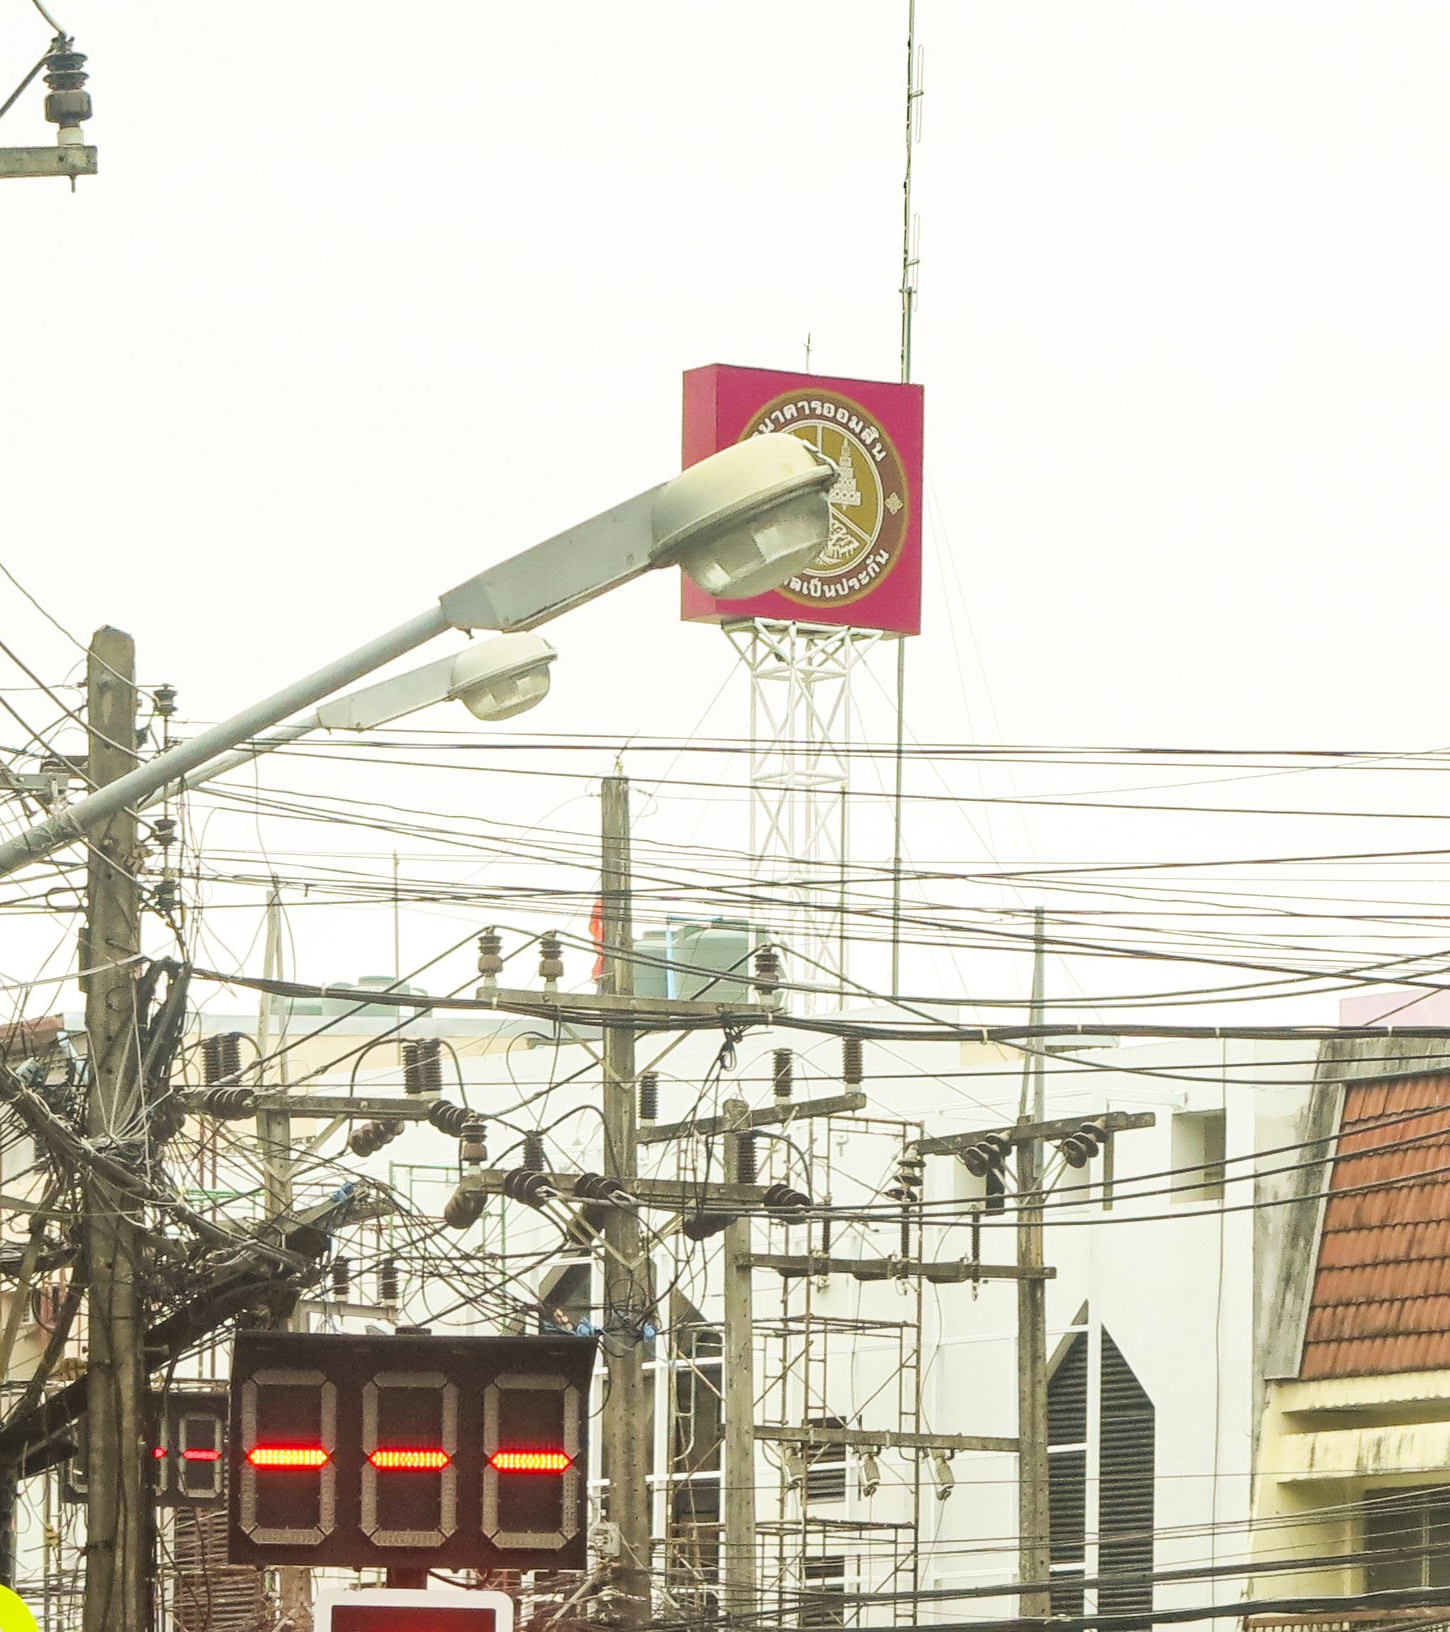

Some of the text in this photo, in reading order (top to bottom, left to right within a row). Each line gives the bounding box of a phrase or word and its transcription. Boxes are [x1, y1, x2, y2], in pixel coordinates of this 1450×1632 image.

[752, 399, 887, 462] นาคารออมสิน
